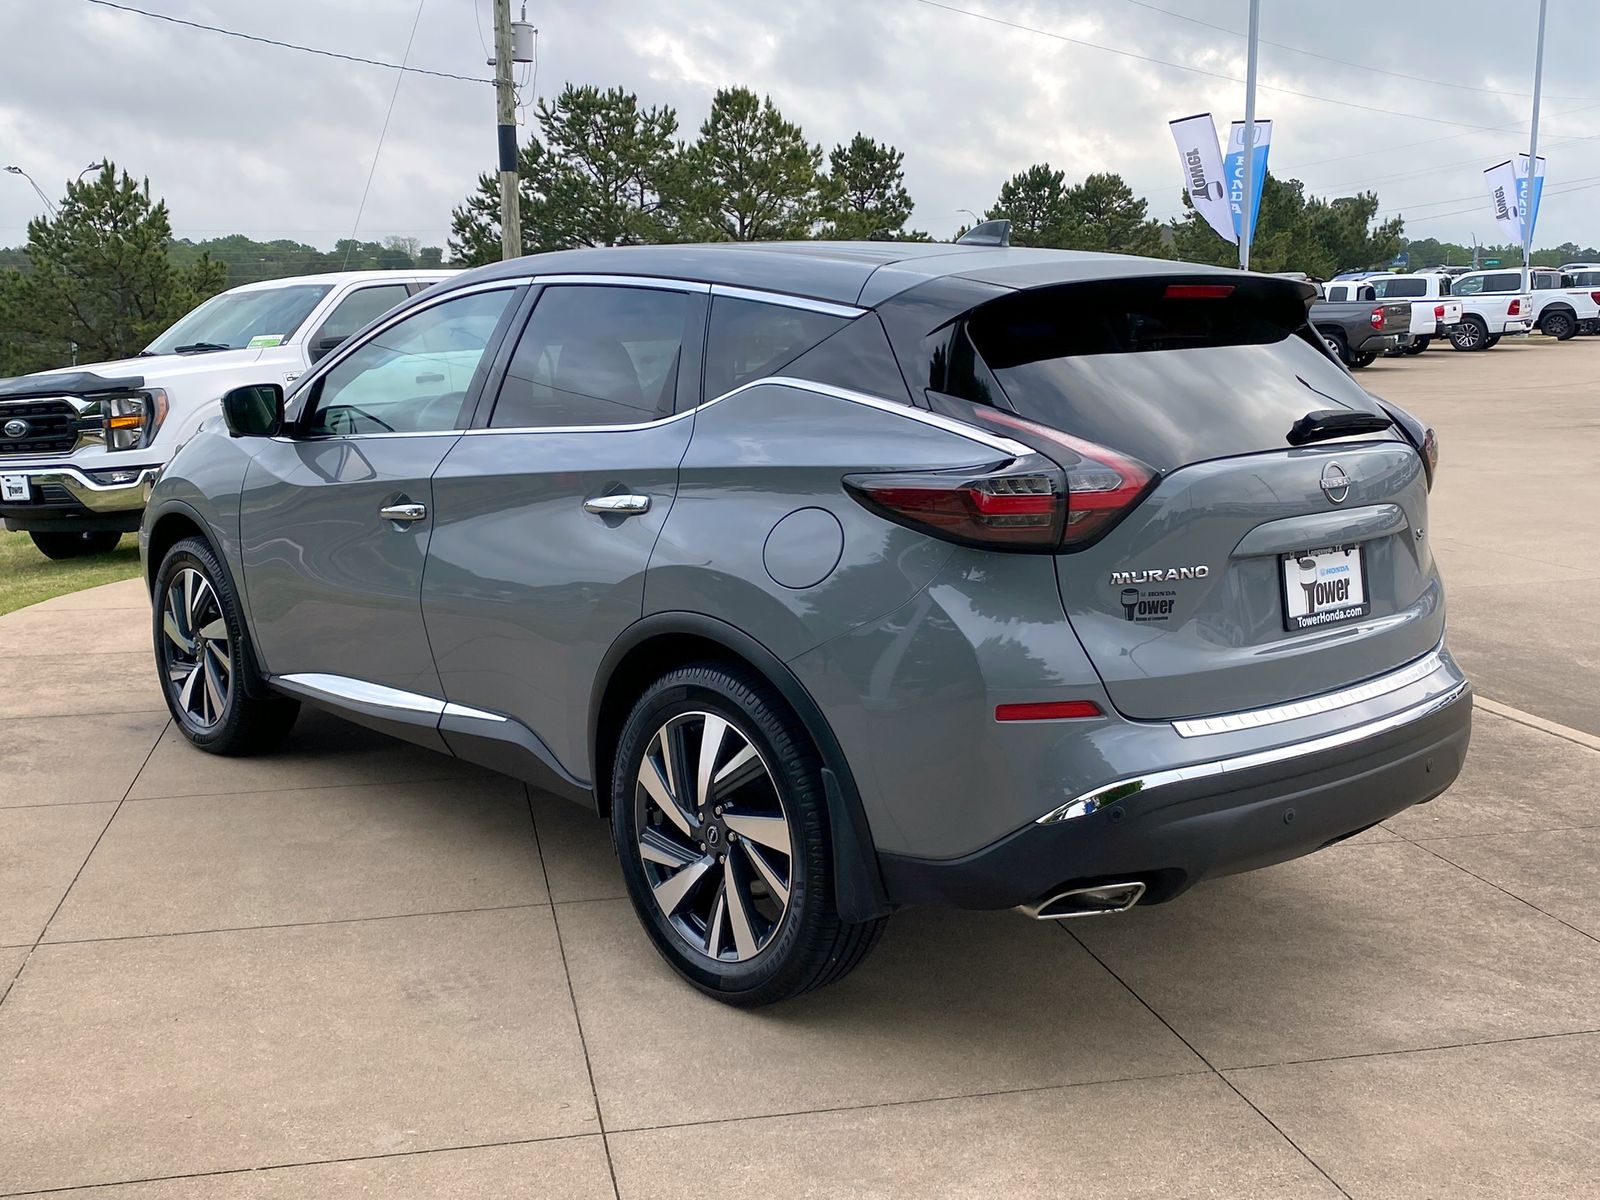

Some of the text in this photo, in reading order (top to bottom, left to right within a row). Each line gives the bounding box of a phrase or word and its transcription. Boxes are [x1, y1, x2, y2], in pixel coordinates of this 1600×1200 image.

[1321, 478, 1350, 488] NISSA
[1110, 565, 1209, 585] MURANO
[1326, 565, 1349, 575] HONDA
[1300, 577, 1350, 614] Tower
[1121, 600, 1174, 621] Tower
[1297, 607, 1362, 628] TowerHonda.com
